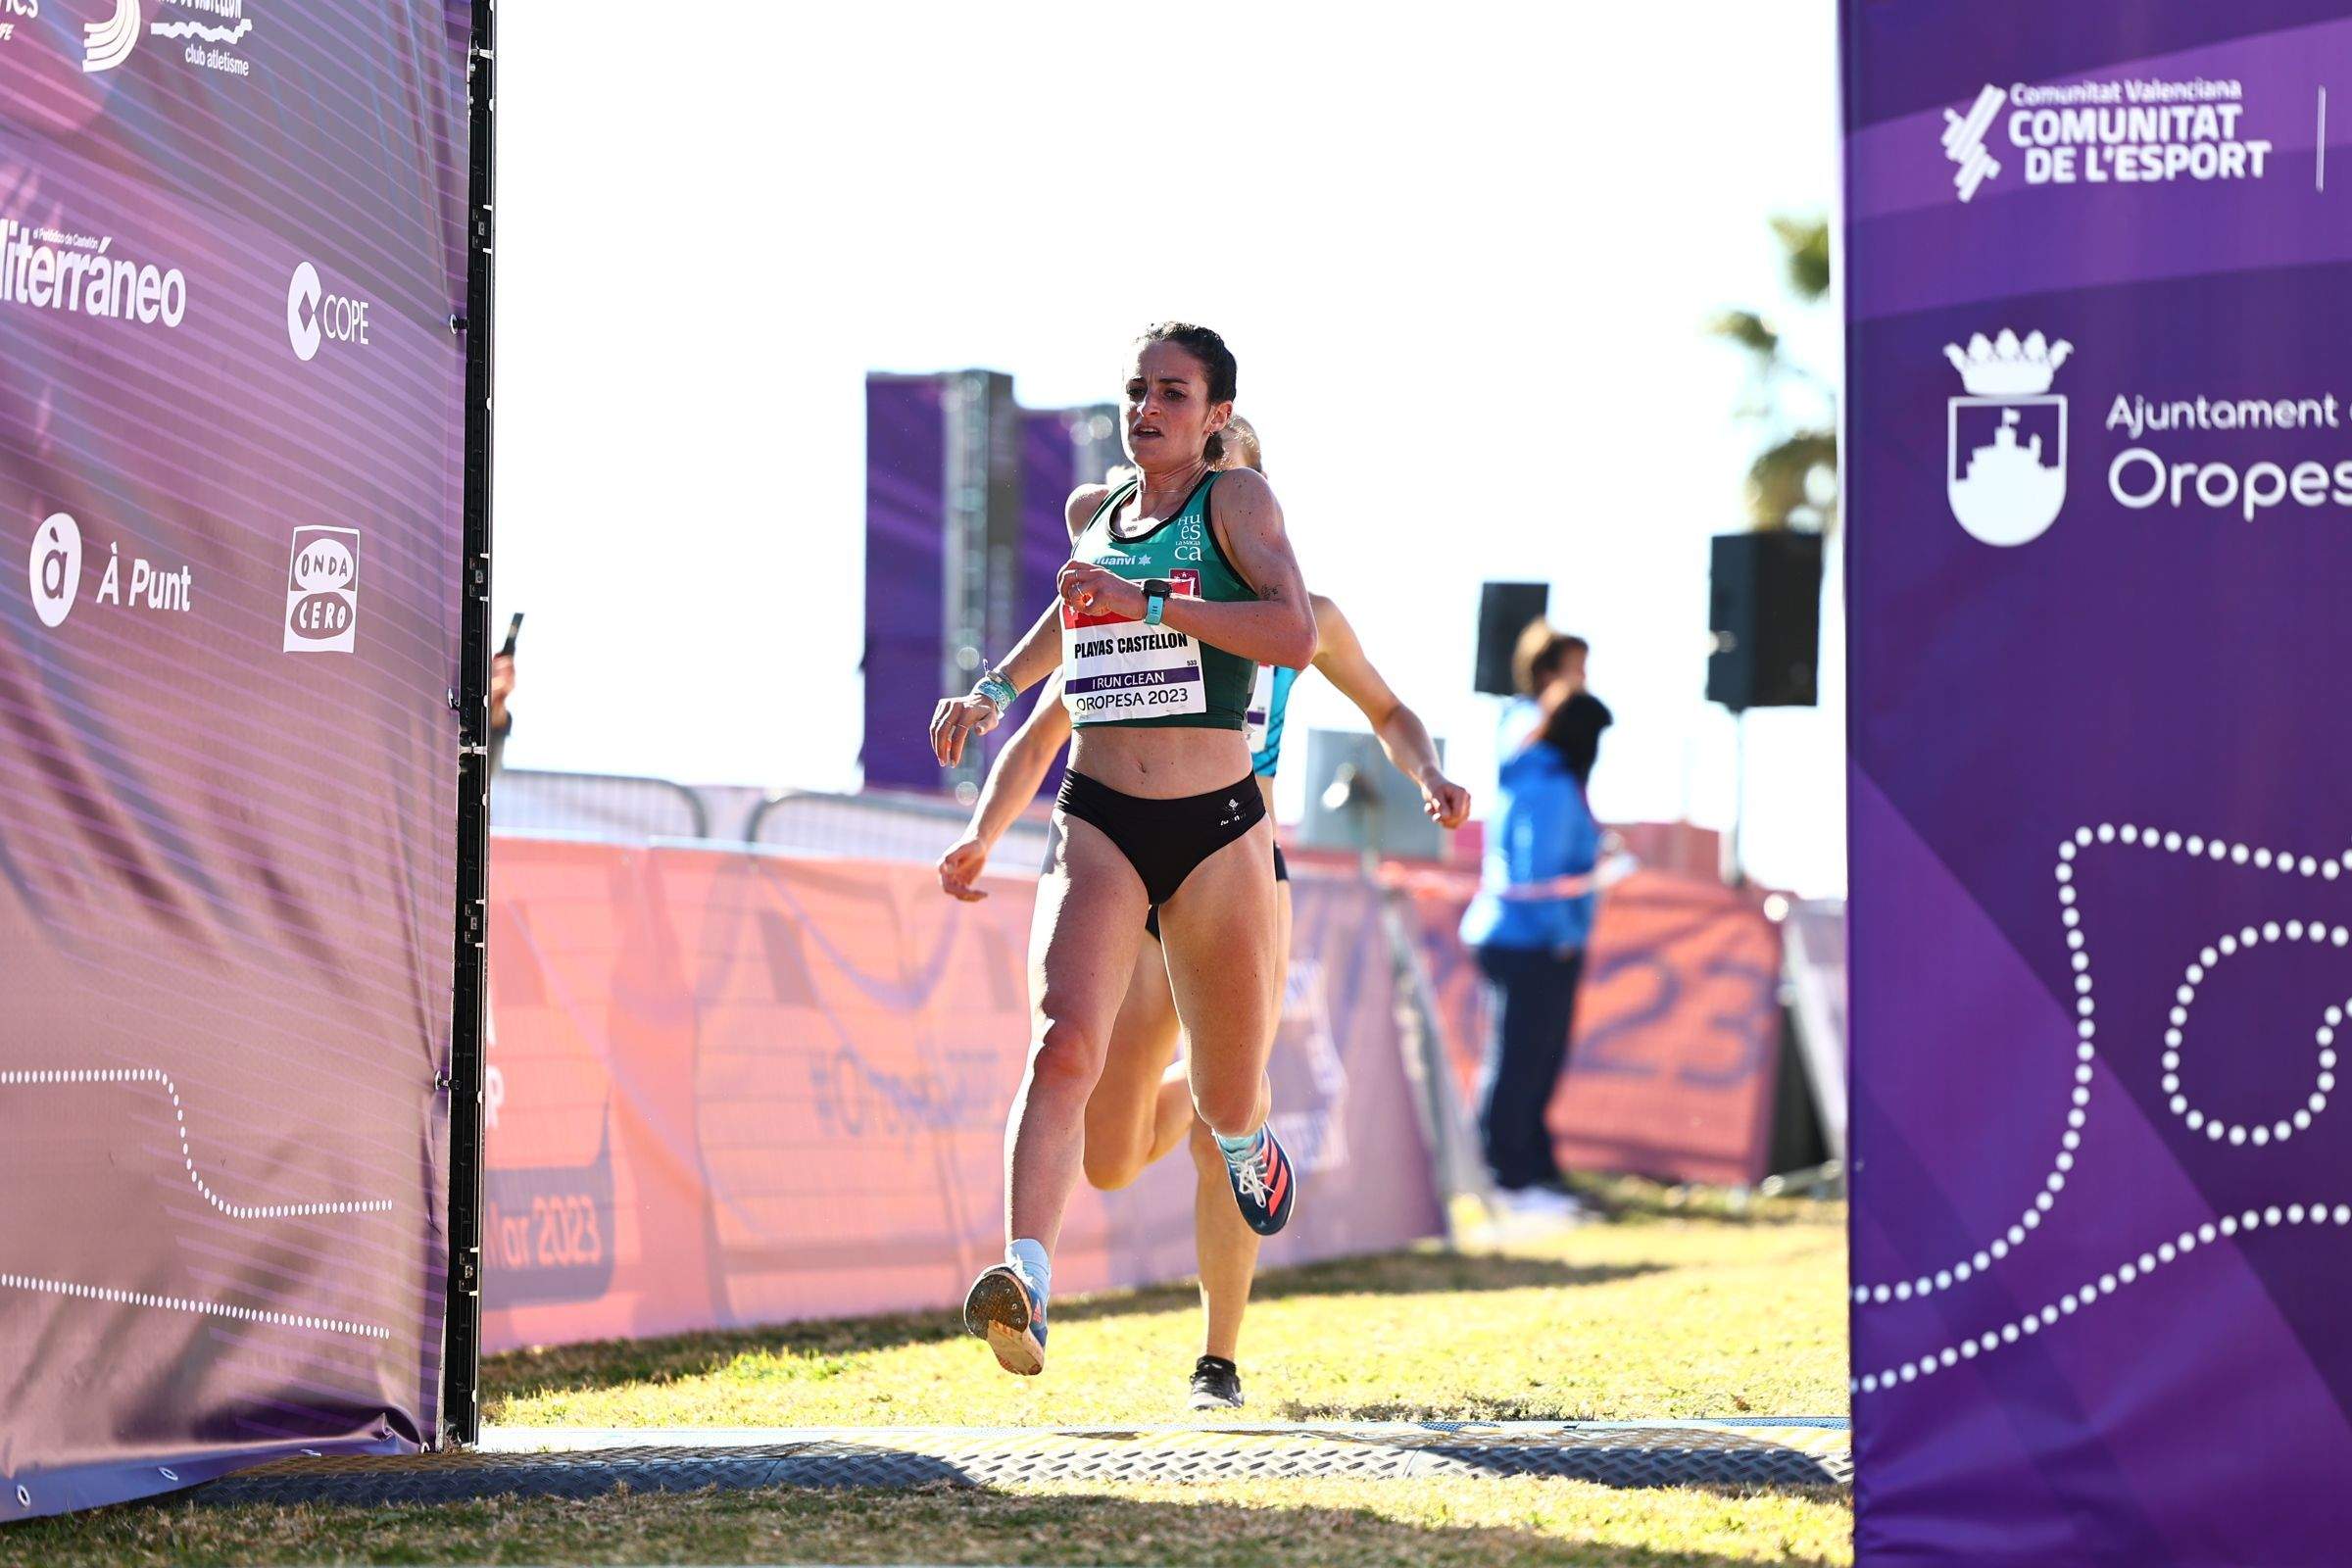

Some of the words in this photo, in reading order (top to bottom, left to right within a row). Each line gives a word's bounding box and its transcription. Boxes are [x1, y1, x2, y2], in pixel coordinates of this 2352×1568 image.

[185, 44, 206, 66] club
[207, 50, 249, 76] atletisme
[2010, 78, 2122, 107] Comunitat
[2124, 75, 2242, 103] Valenciana
[2007, 102, 2243, 148] COMUNITAT
[2024, 146, 2078, 184] DE
[2083, 139, 2274, 183] L'ESPORT
[324, 294, 369, 345] COPE
[2106, 391, 2339, 440] Ajuntament
[301, 554, 348, 577] ONDA
[128, 559, 192, 612] Punt
[299, 601, 347, 629] CERO
[1074, 639, 1114, 660] PLAYAS
[1117, 632, 1189, 655] CASTELLON
[1097, 674, 1122, 689] RUN
[1124, 671, 1165, 686] CLEAN
[1076, 692, 1145, 711] OROPESA
[1148, 688, 1189, 705] 2023
[533, 1195, 602, 1269] 2023
